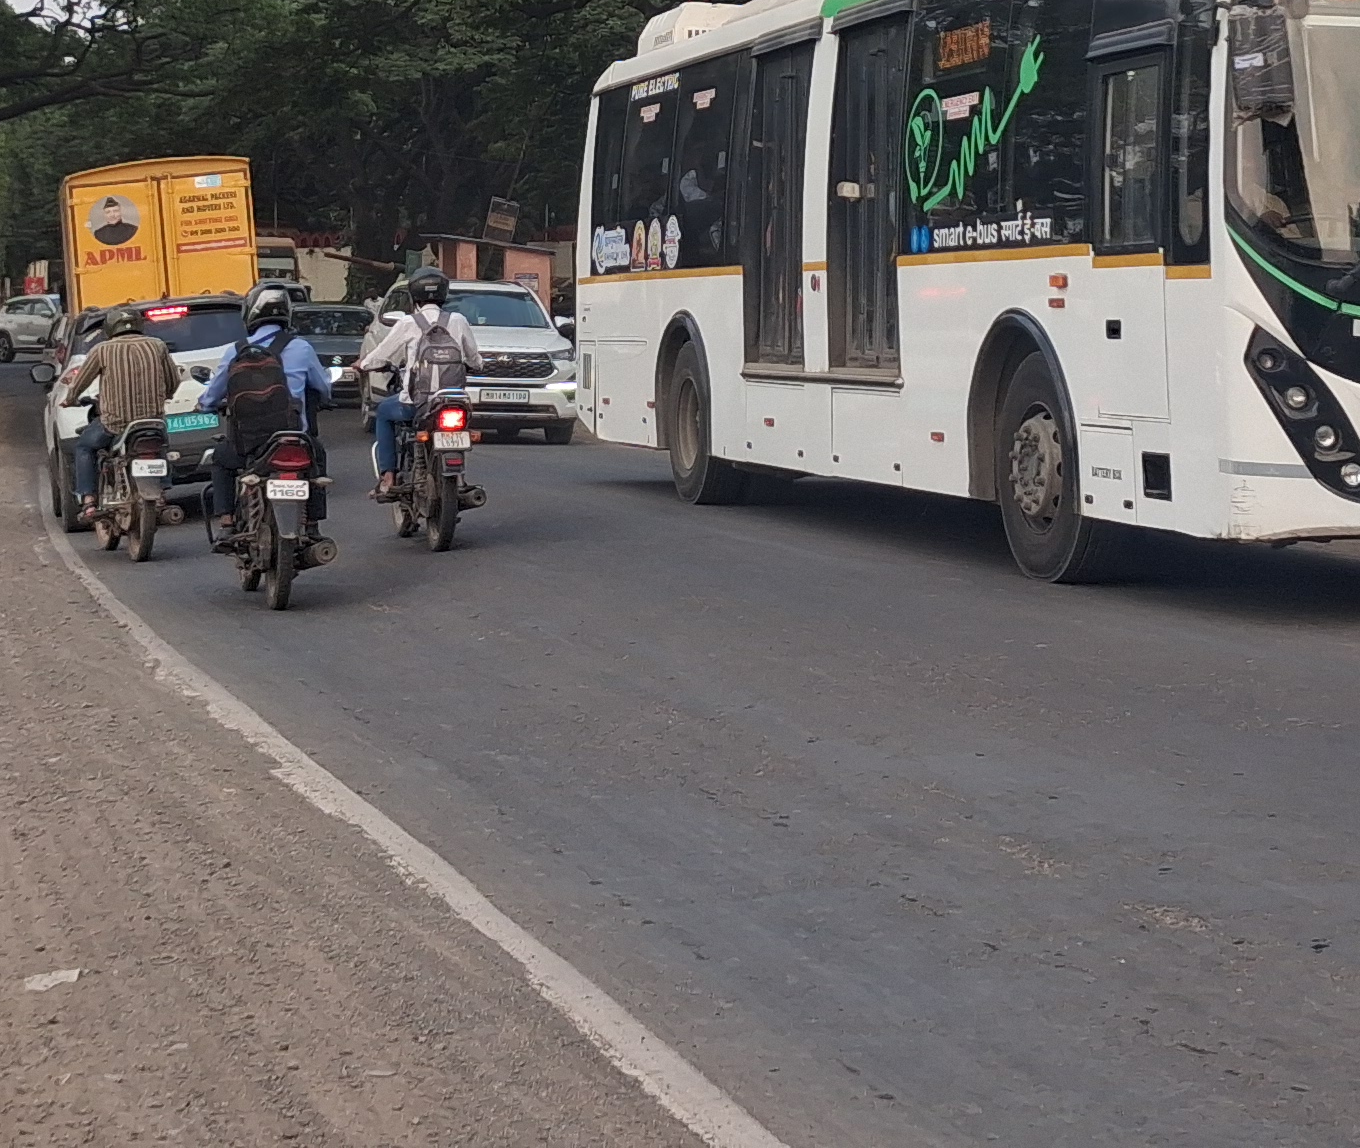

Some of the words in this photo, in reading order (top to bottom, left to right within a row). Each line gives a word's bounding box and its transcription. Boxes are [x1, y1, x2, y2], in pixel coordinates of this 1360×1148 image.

[631, 80, 649, 101] PURE
[648, 71, 680, 96] ELECTRIC
[933, 221, 964, 248] smart
[965, 217, 998, 245] e-bus
[84, 246, 148, 267] APML
[270, 489, 307, 498] 1160
